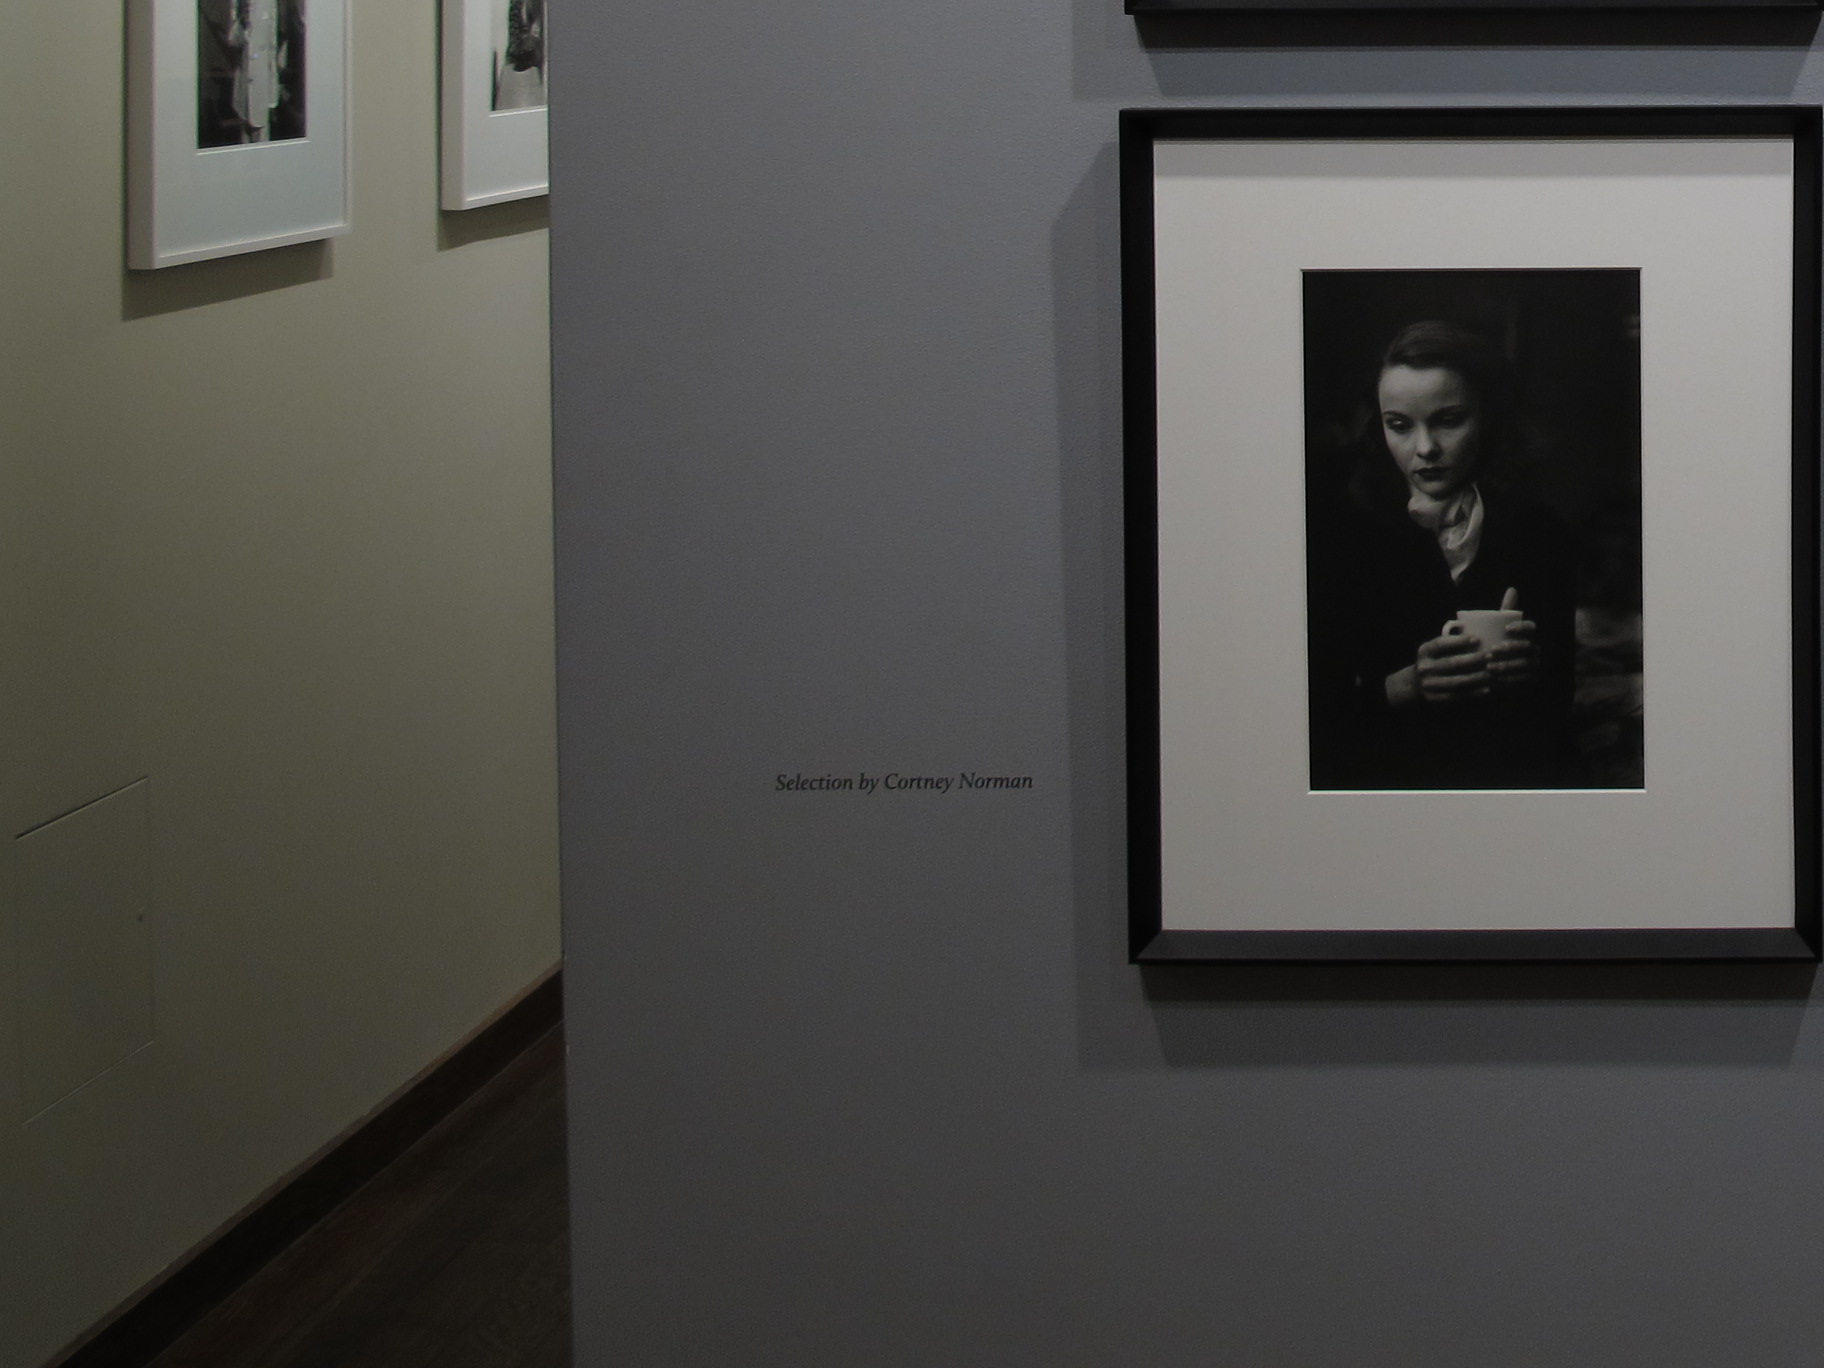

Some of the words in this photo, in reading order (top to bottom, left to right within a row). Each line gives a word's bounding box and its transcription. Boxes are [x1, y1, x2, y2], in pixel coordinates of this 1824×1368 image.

[775, 773, 854, 791] Selection
[859, 772, 879, 795] by
[884, 772, 954, 794] Cortney
[958, 772, 1034, 790] Norman
